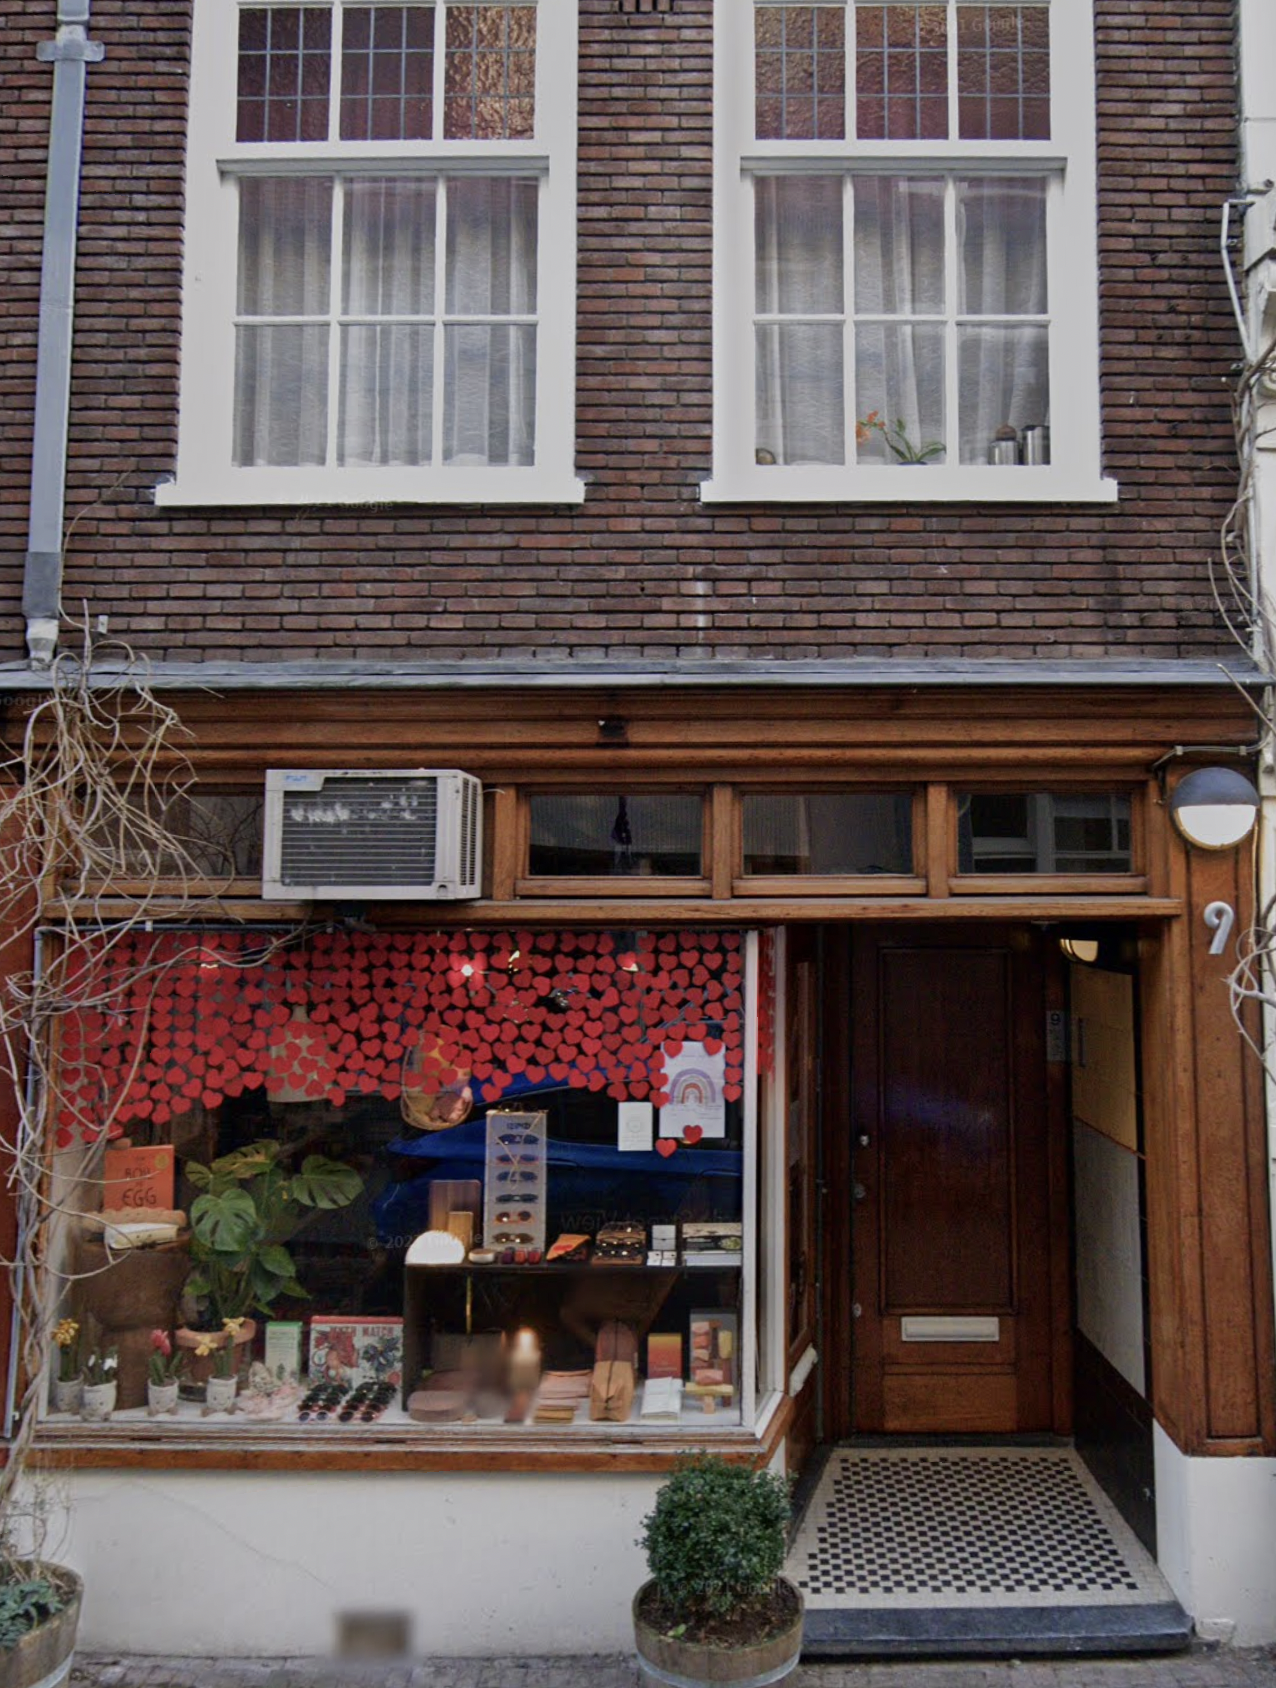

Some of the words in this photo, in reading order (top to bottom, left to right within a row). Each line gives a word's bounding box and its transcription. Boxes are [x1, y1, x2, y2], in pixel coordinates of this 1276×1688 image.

[1204, 901, 1234, 955] 9
[1050, 1013, 1062, 1026] 9
[122, 1186, 158, 1207] EGG
